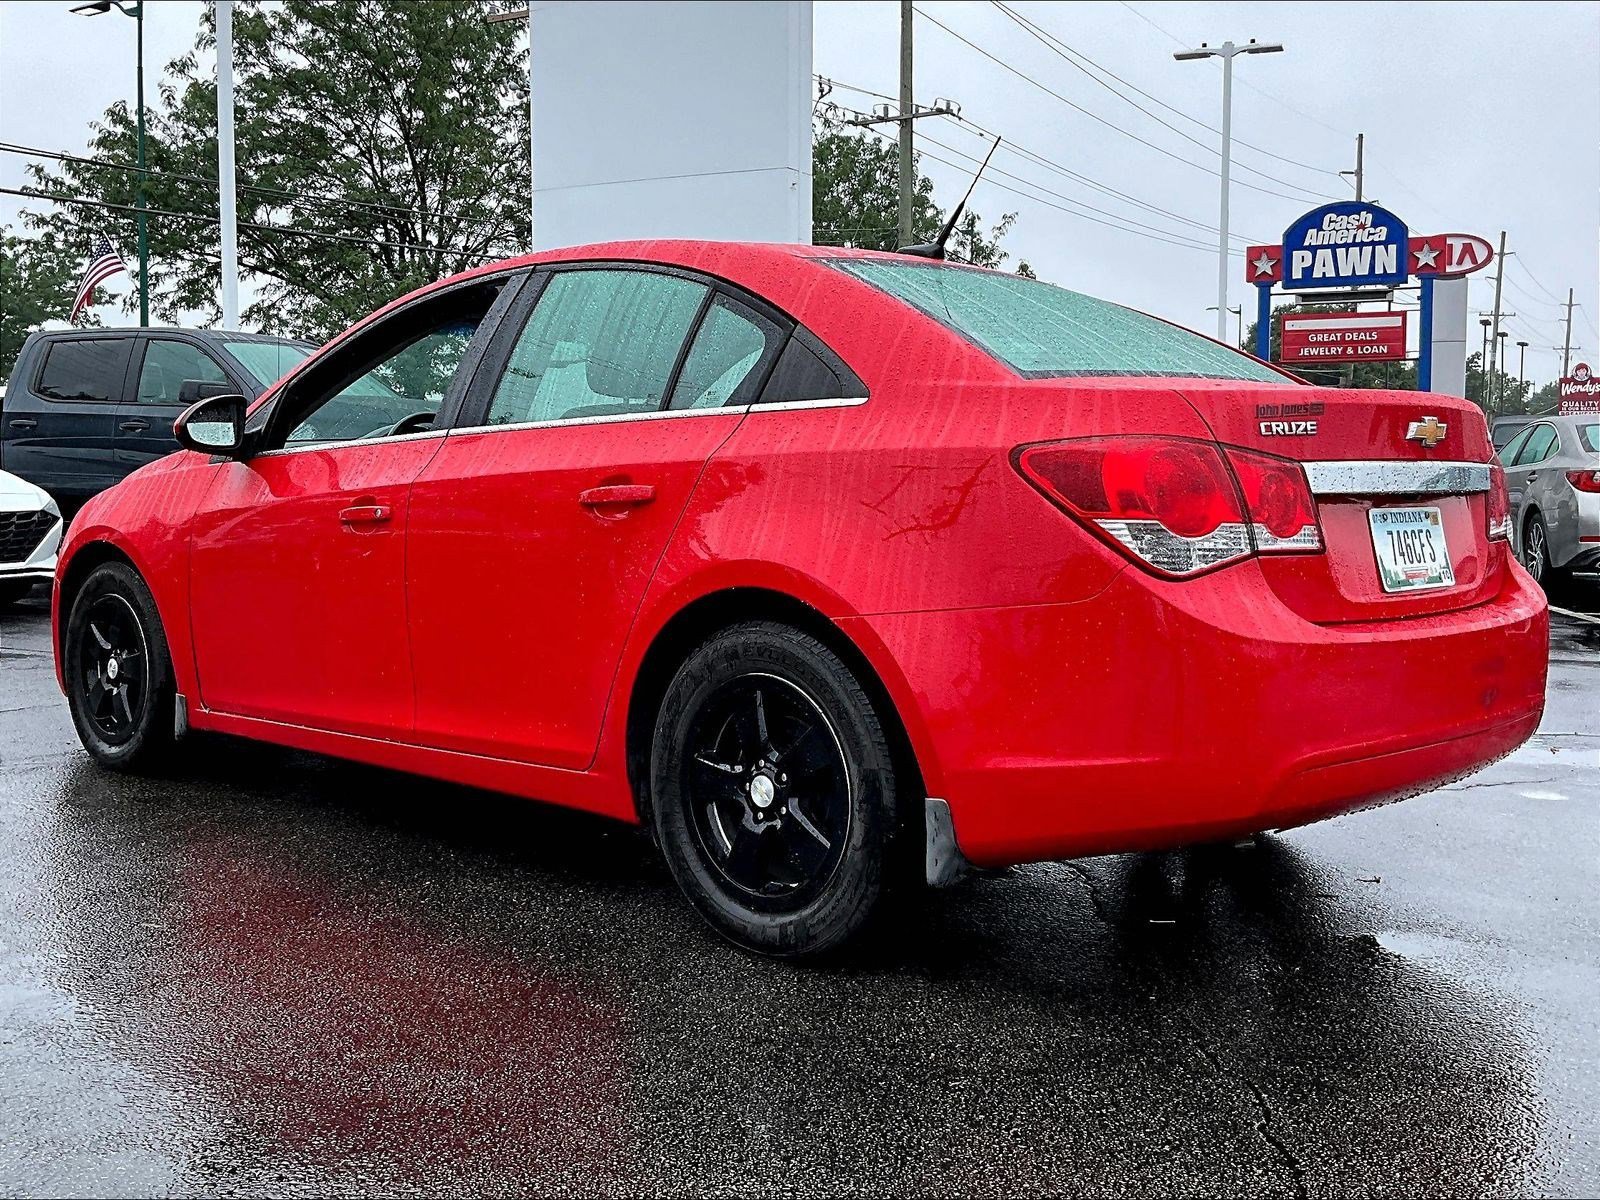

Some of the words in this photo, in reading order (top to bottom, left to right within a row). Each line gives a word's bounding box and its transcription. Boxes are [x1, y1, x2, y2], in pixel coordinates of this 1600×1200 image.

[1322, 211, 1373, 231] Cash
[1303, 226, 1388, 246] America
[1292, 244, 1397, 279] PAWN
[1446, 242, 1479, 266] IA
[1308, 333, 1342, 342] GREAT
[1345, 331, 1378, 341] DEALS
[1299, 346, 1343, 356] JEWELRY
[1346, 346, 1354, 355] &
[1357, 345, 1388, 354] LOAN
[1561, 380, 1600, 396] Wendy's
[1255, 404, 1279, 419] John
[1281, 403, 1309, 417] Jones
[1260, 421, 1318, 436] CRUZE
[1390, 511, 1424, 524] INDIANA
[1386, 528, 1437, 566] 746CFS
